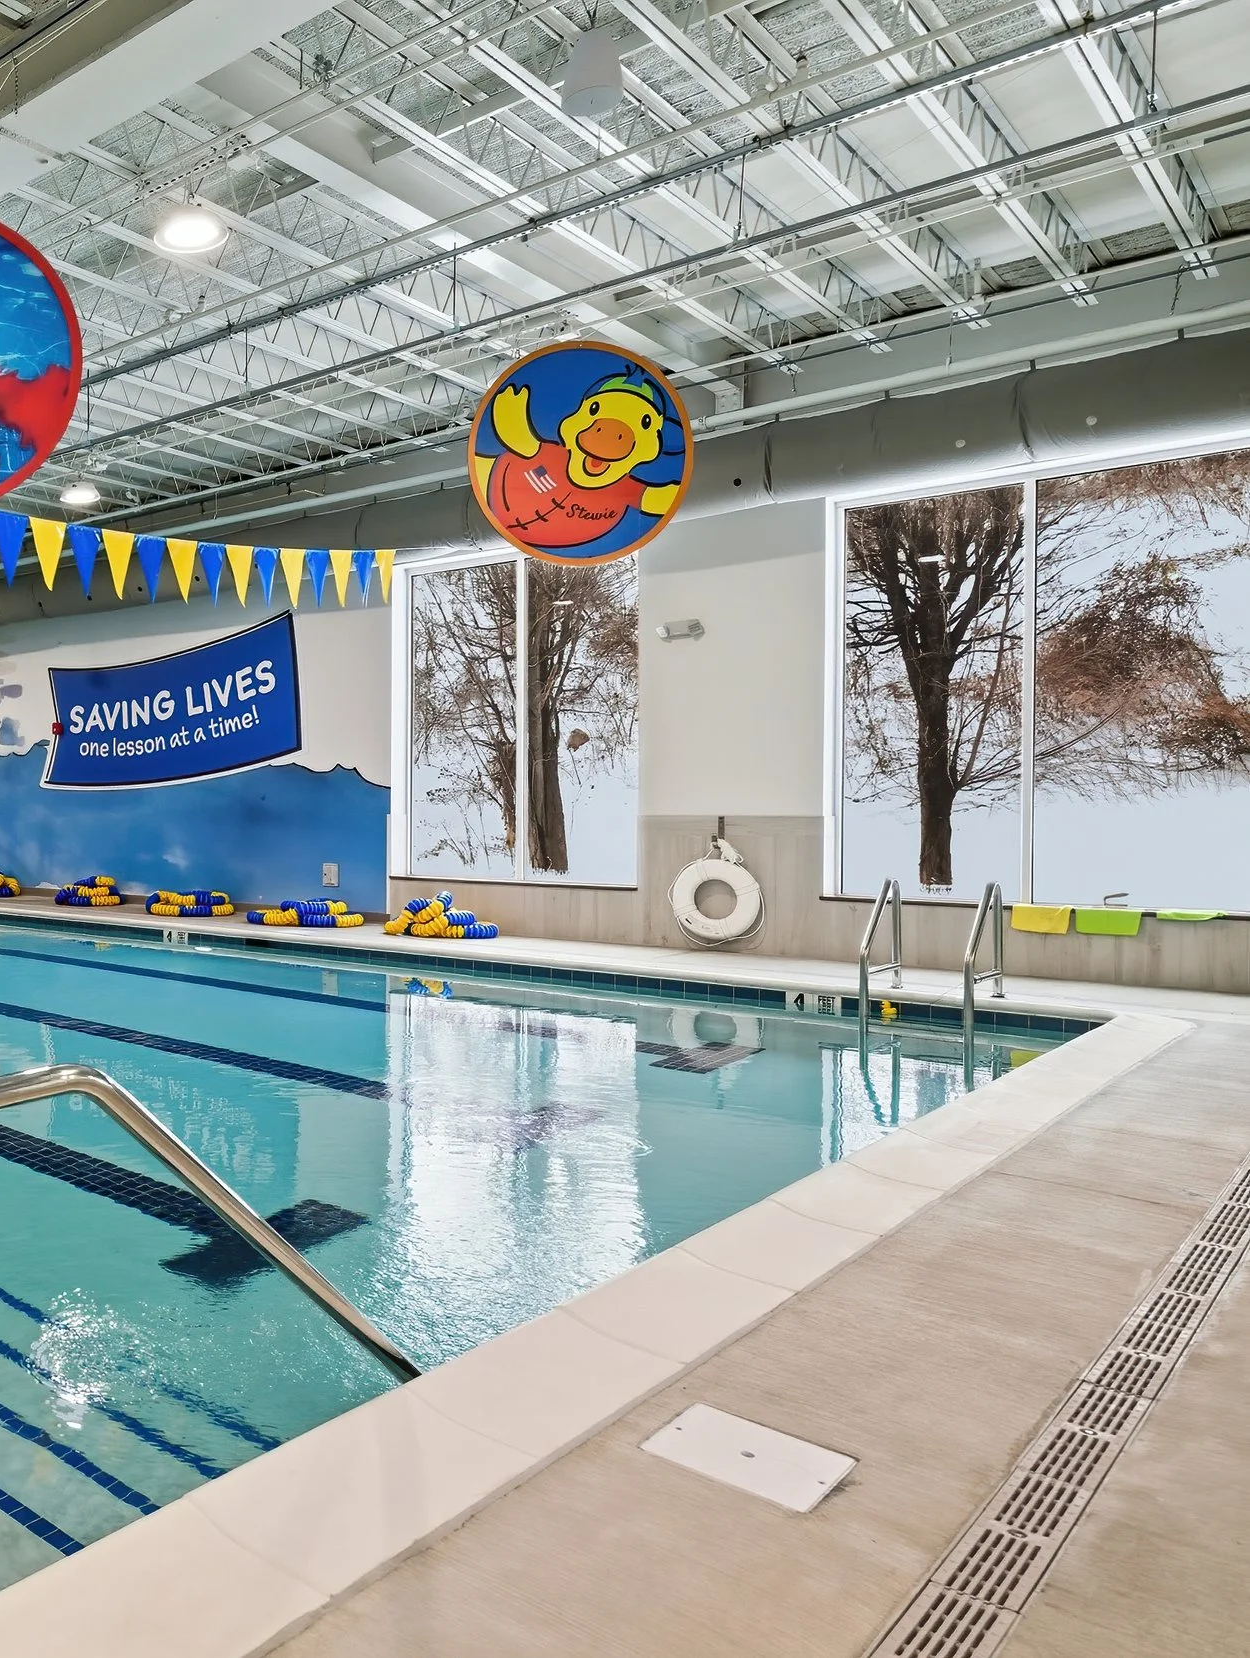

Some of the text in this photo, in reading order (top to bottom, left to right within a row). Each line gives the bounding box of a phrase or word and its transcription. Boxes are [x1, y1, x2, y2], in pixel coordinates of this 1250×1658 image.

[565, 503, 619, 521] Stewie
[68, 659, 277, 735] SAVING LIVES
[79, 704, 261, 758] one lesson at a time!
